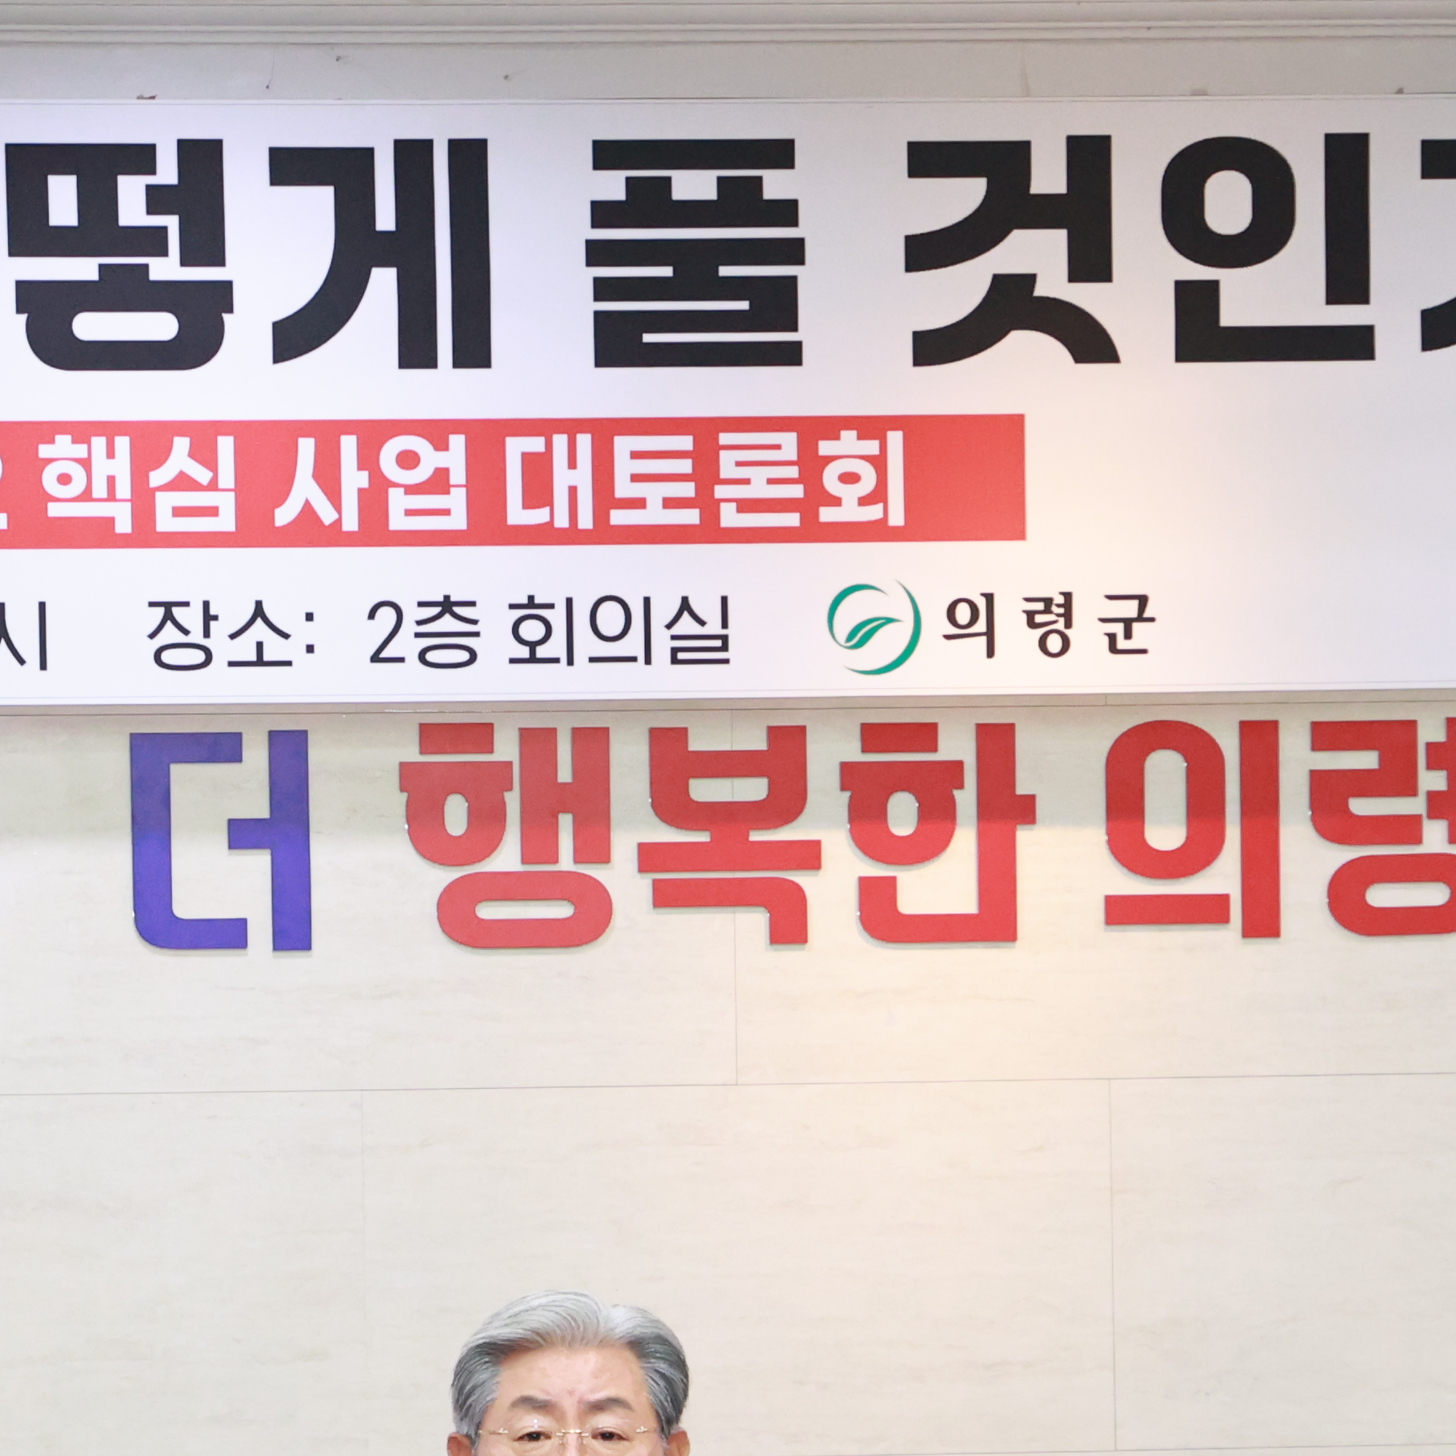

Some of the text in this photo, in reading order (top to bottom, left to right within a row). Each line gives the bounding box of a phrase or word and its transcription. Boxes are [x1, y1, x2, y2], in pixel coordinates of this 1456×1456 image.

[585, 138, 805, 368] 풀
[38, 435, 236, 533] 핵심
[274, 434, 467, 531] 사업
[505, 430, 905, 529] 대토론회
[147, 595, 730, 671] 장소: 2층 회의실
[129, 729, 312, 952] 더
[399, 722, 1036, 949] 행복한
